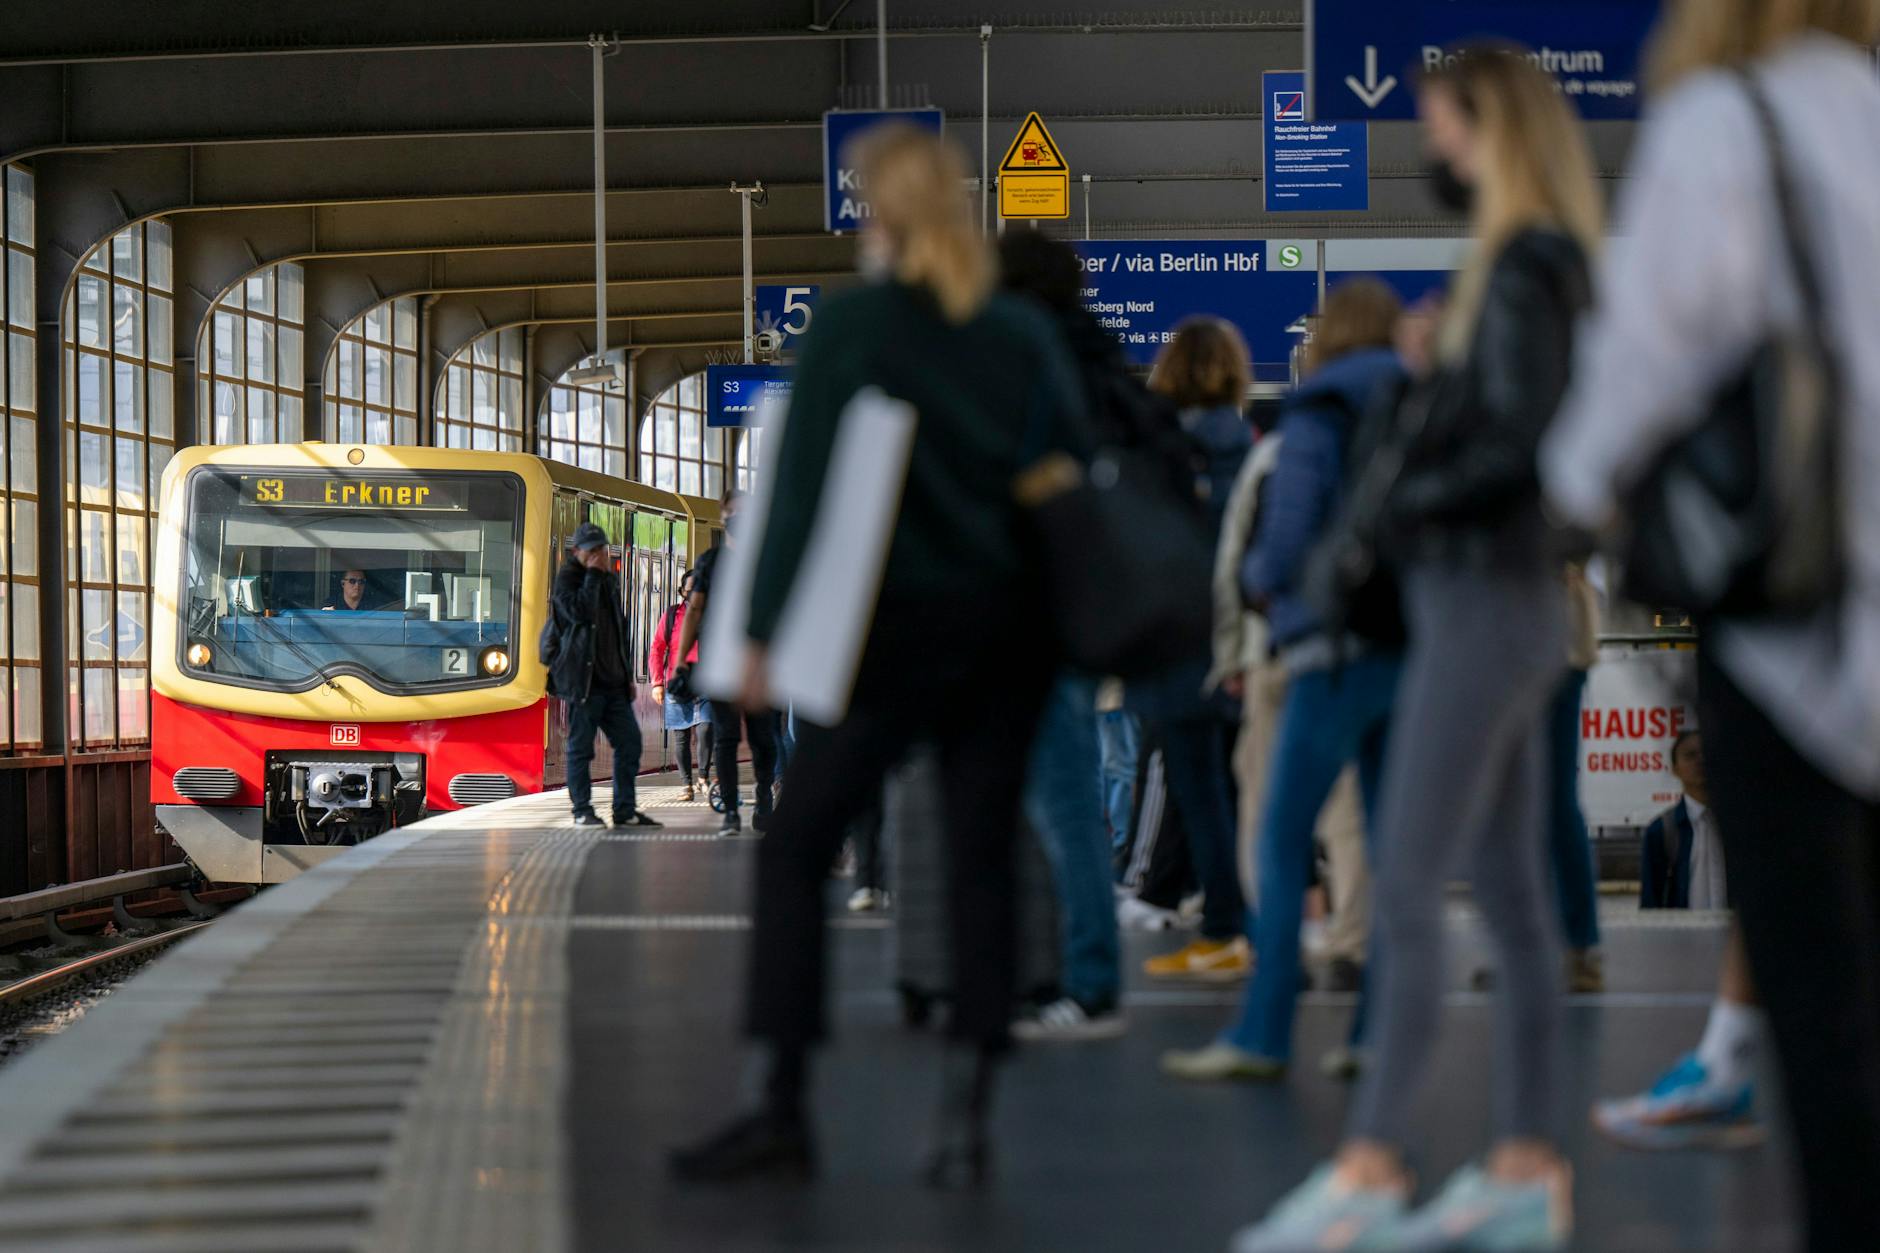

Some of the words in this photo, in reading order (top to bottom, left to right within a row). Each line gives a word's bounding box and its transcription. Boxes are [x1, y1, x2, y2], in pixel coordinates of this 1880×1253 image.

[1274, 125, 1310, 133] Rauchfreier
[1310, 124, 1336, 132] Bahnhof
[1111, 252, 1121, 272] /
[1125, 252, 1155, 272] via
[1159, 252, 1219, 272] Berlin
[1224, 252, 1260, 272] Hbf
[1076, 287, 1100, 298] ner
[782, 287, 814, 335] 5
[1080, 301, 1124, 315] usberg
[1126, 301, 1155, 313] Nord
[1128, 332, 1146, 344] via
[723, 380, 740, 393] S3
[256, 478, 284, 503] S3
[324, 479, 430, 506] Erkner
[447, 649, 461, 672] 2
[334, 728, 356, 742] DB
